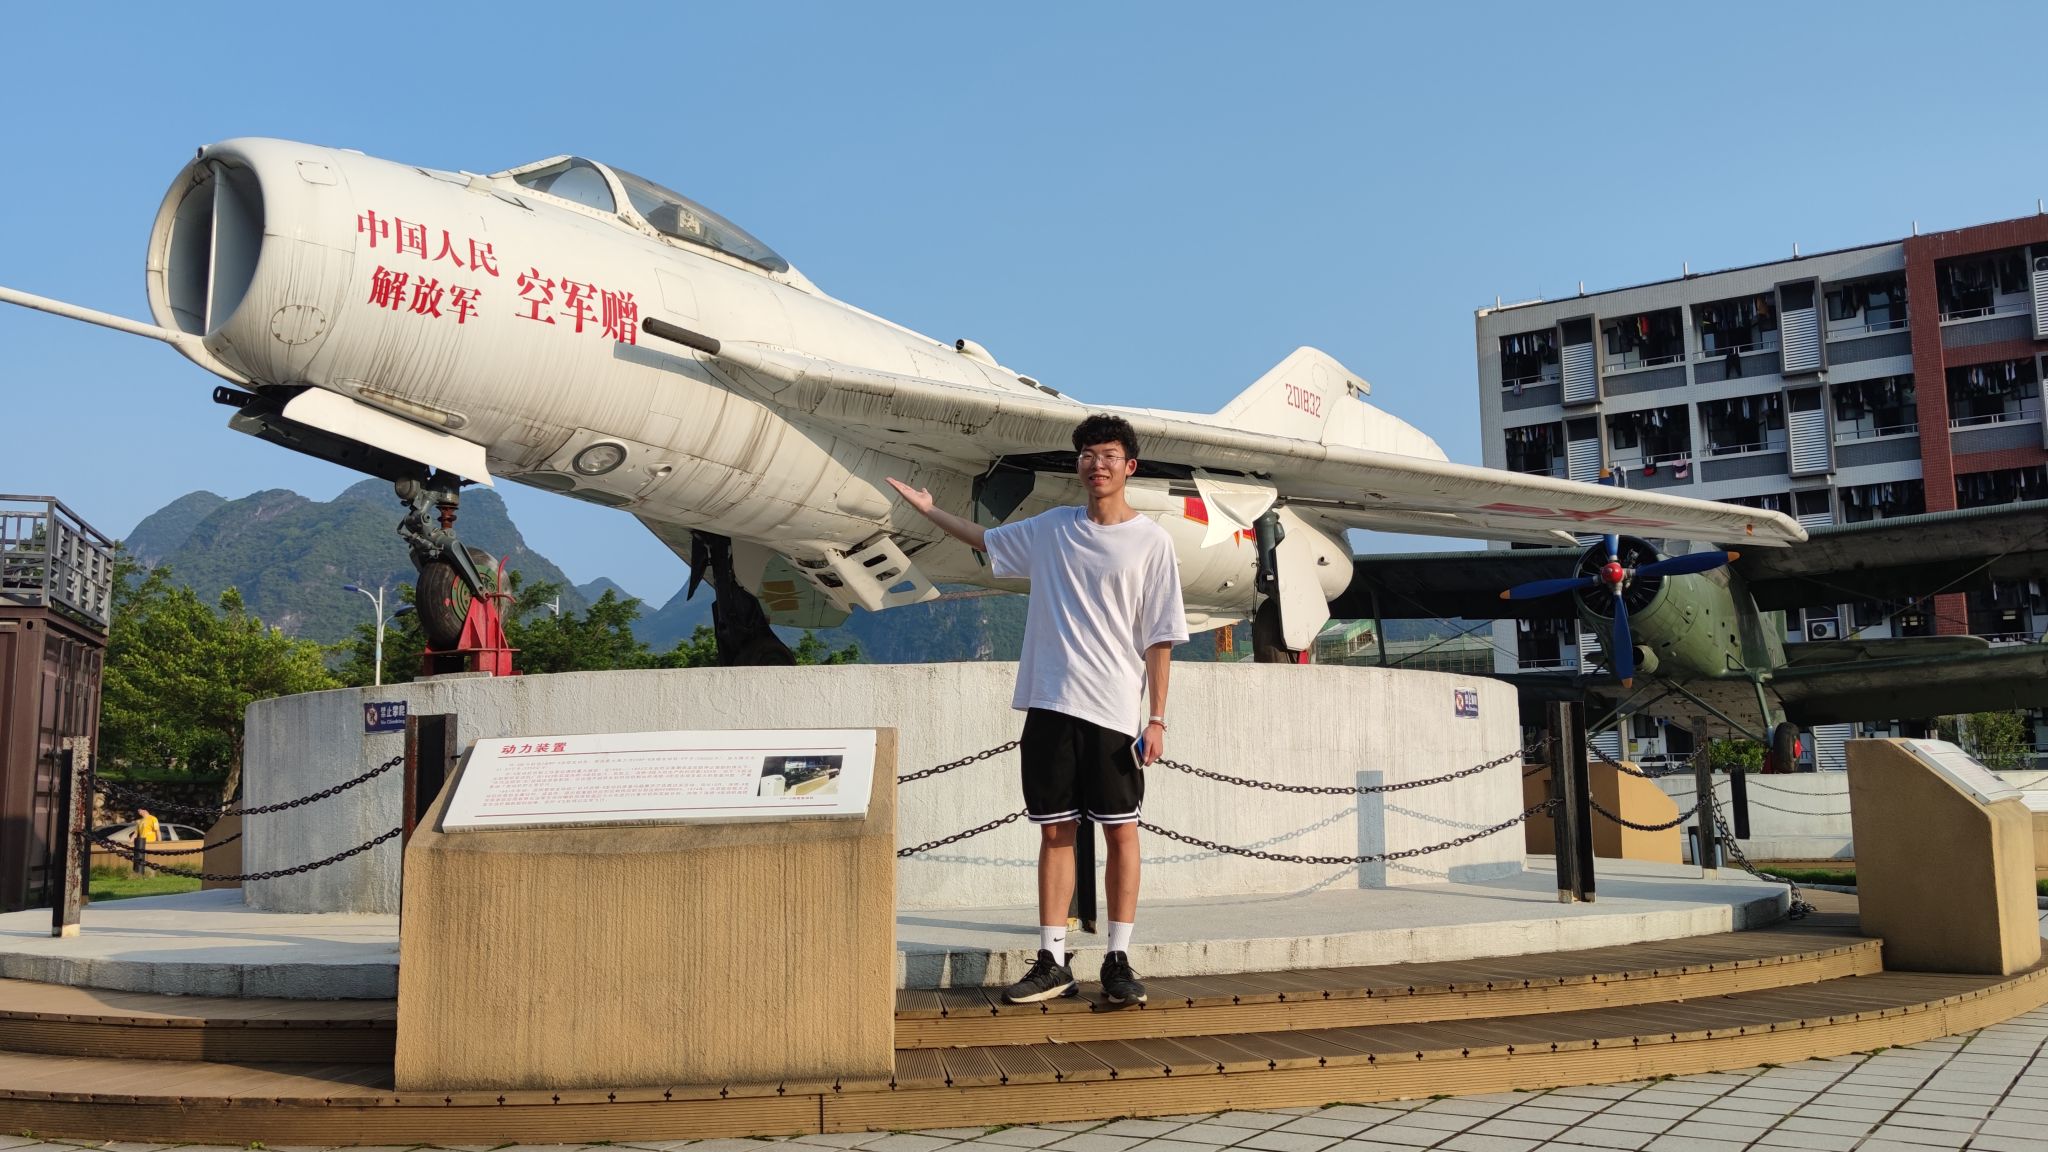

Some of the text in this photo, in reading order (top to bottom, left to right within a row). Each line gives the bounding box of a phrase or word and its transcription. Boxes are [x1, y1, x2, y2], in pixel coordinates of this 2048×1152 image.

[357, 209, 499, 277] 中国人民
[367, 265, 482, 324] 解放军
[515, 267, 638, 345] 空军赠
[1285, 383, 1321, 418] 201832
[501, 742, 567, 754] 动力装置
